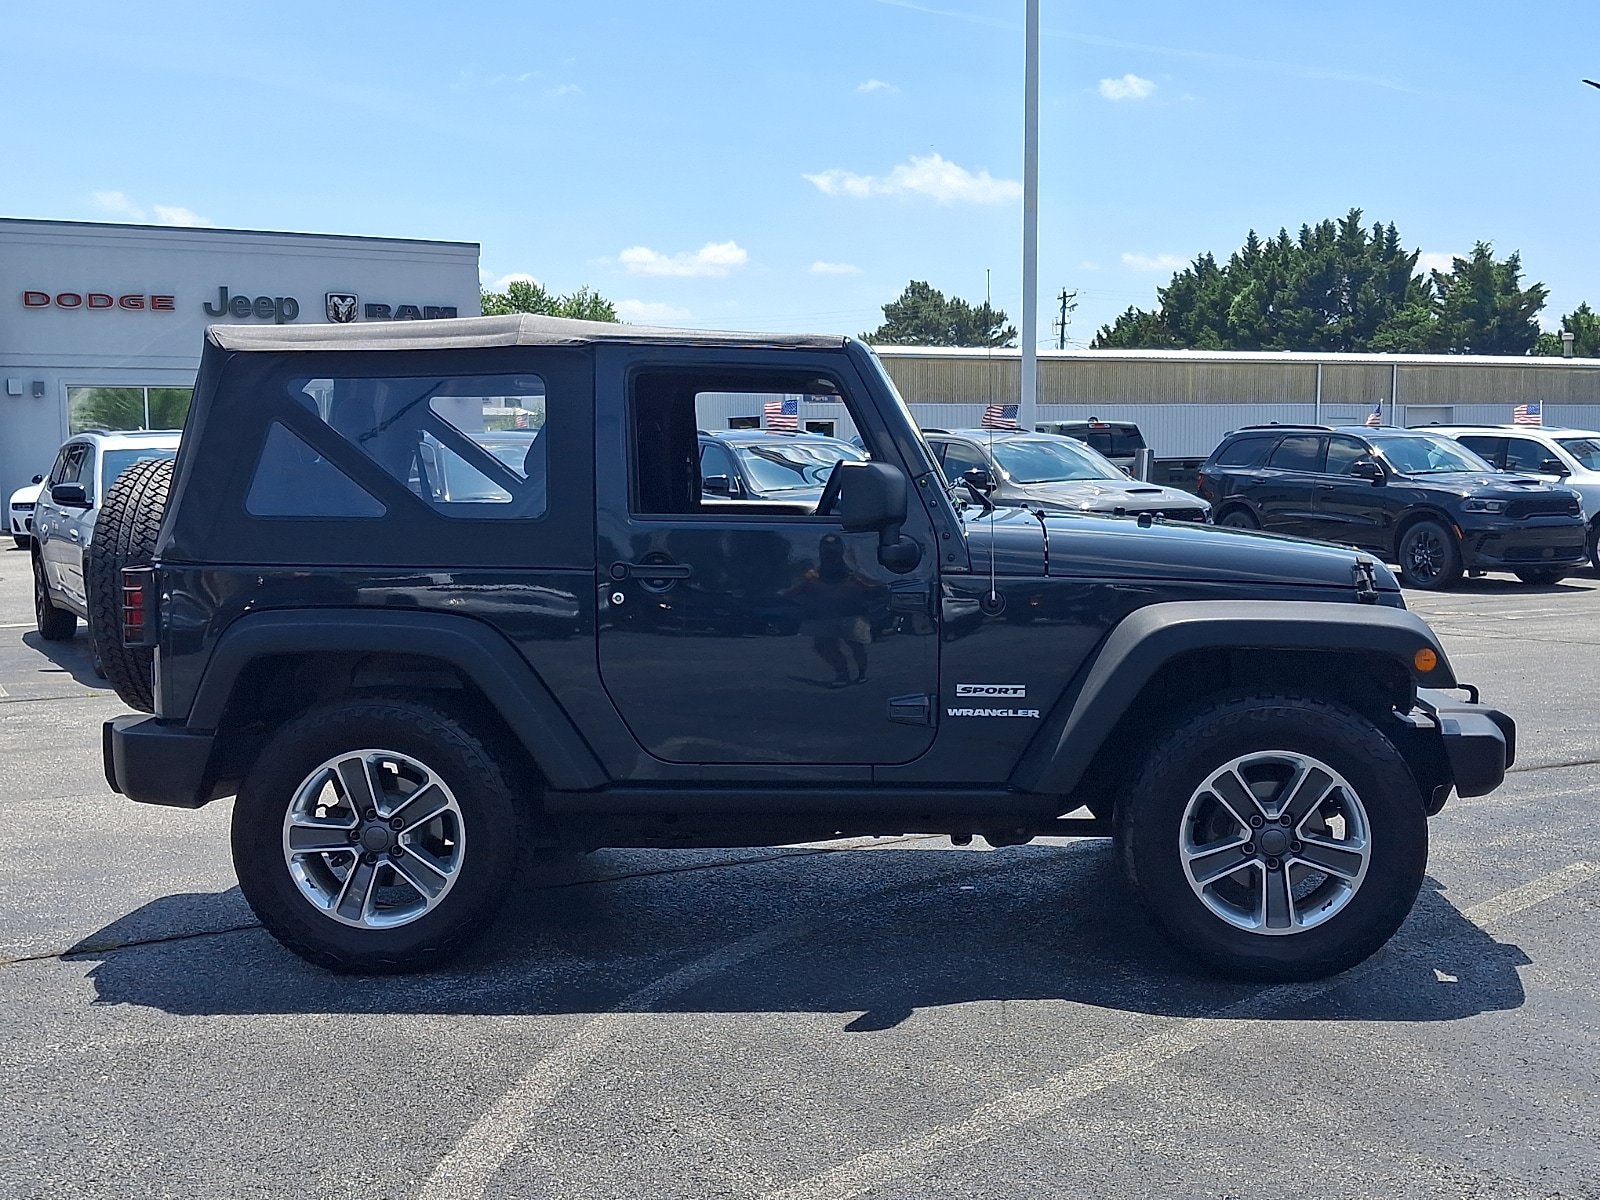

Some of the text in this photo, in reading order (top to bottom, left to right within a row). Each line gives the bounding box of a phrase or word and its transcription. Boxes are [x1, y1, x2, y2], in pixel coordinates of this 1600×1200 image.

[23, 290, 175, 312] DODGE
[203, 286, 300, 325] Jeep
[364, 303, 458, 321] RAM
[958, 685, 1025, 696] SPORT
[947, 708, 1041, 719] WRANGLER
